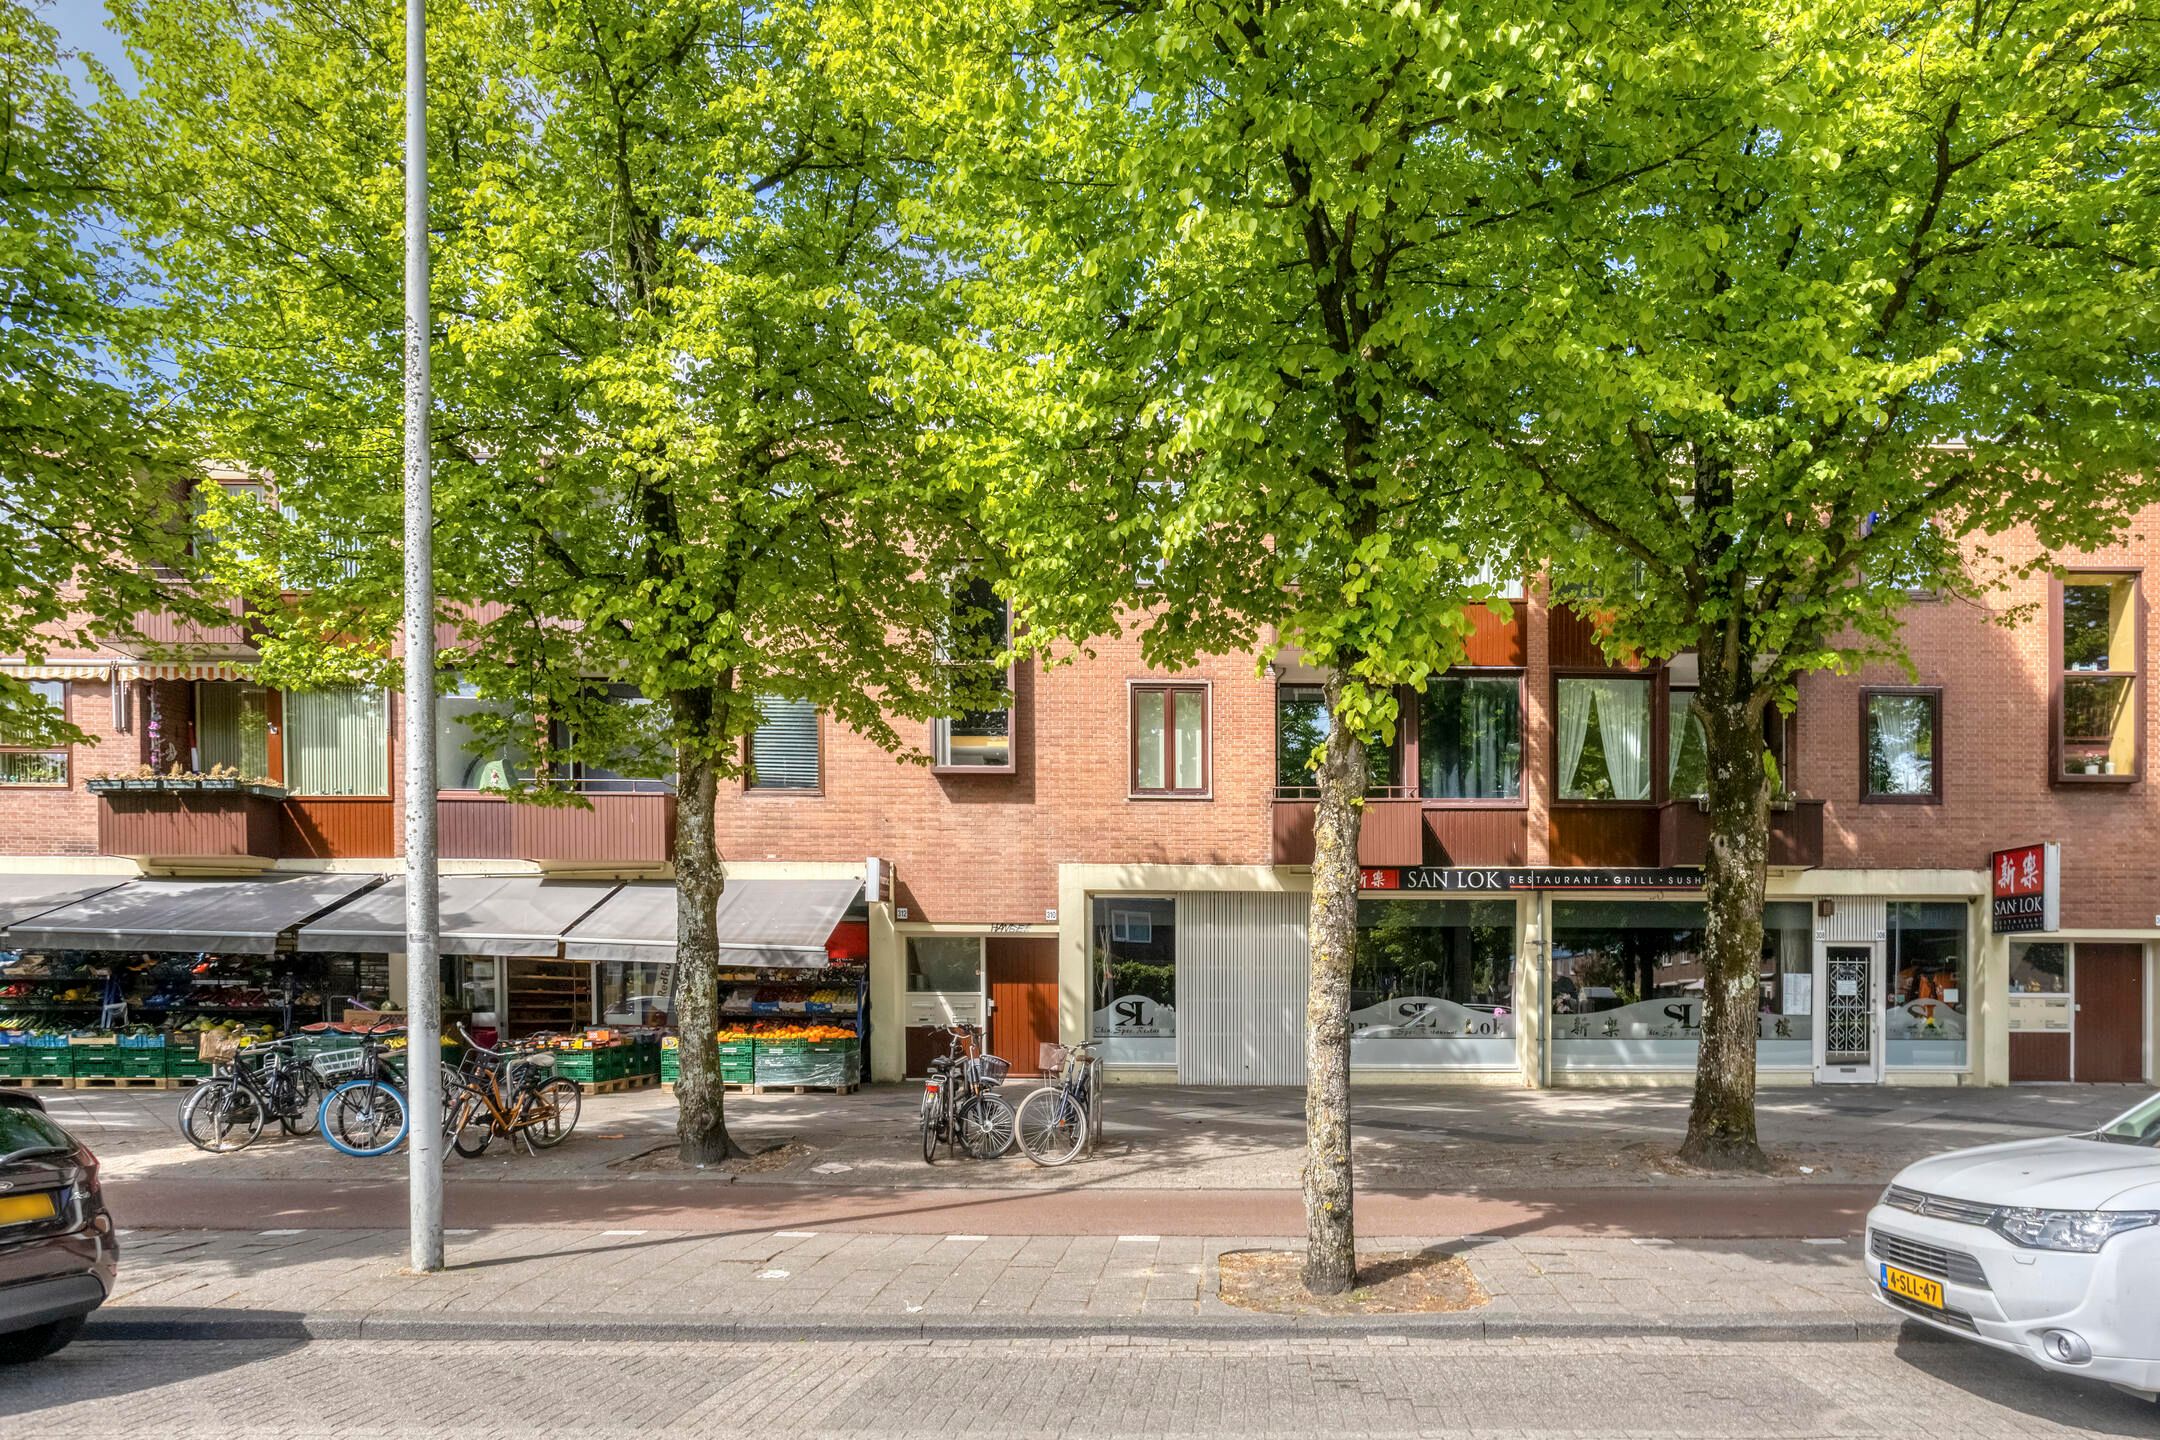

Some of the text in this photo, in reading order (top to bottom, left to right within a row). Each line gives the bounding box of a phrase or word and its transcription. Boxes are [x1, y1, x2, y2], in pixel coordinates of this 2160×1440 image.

[1407, 870, 1501, 888] SAN LOK
[1509, 875, 1599, 884] RESTAURANT
[1614, 875, 1654, 885] GRILL
[1994, 896, 2042, 916] SAN LOK
[1891, 1272, 1937, 1302] 4-SLL-47
